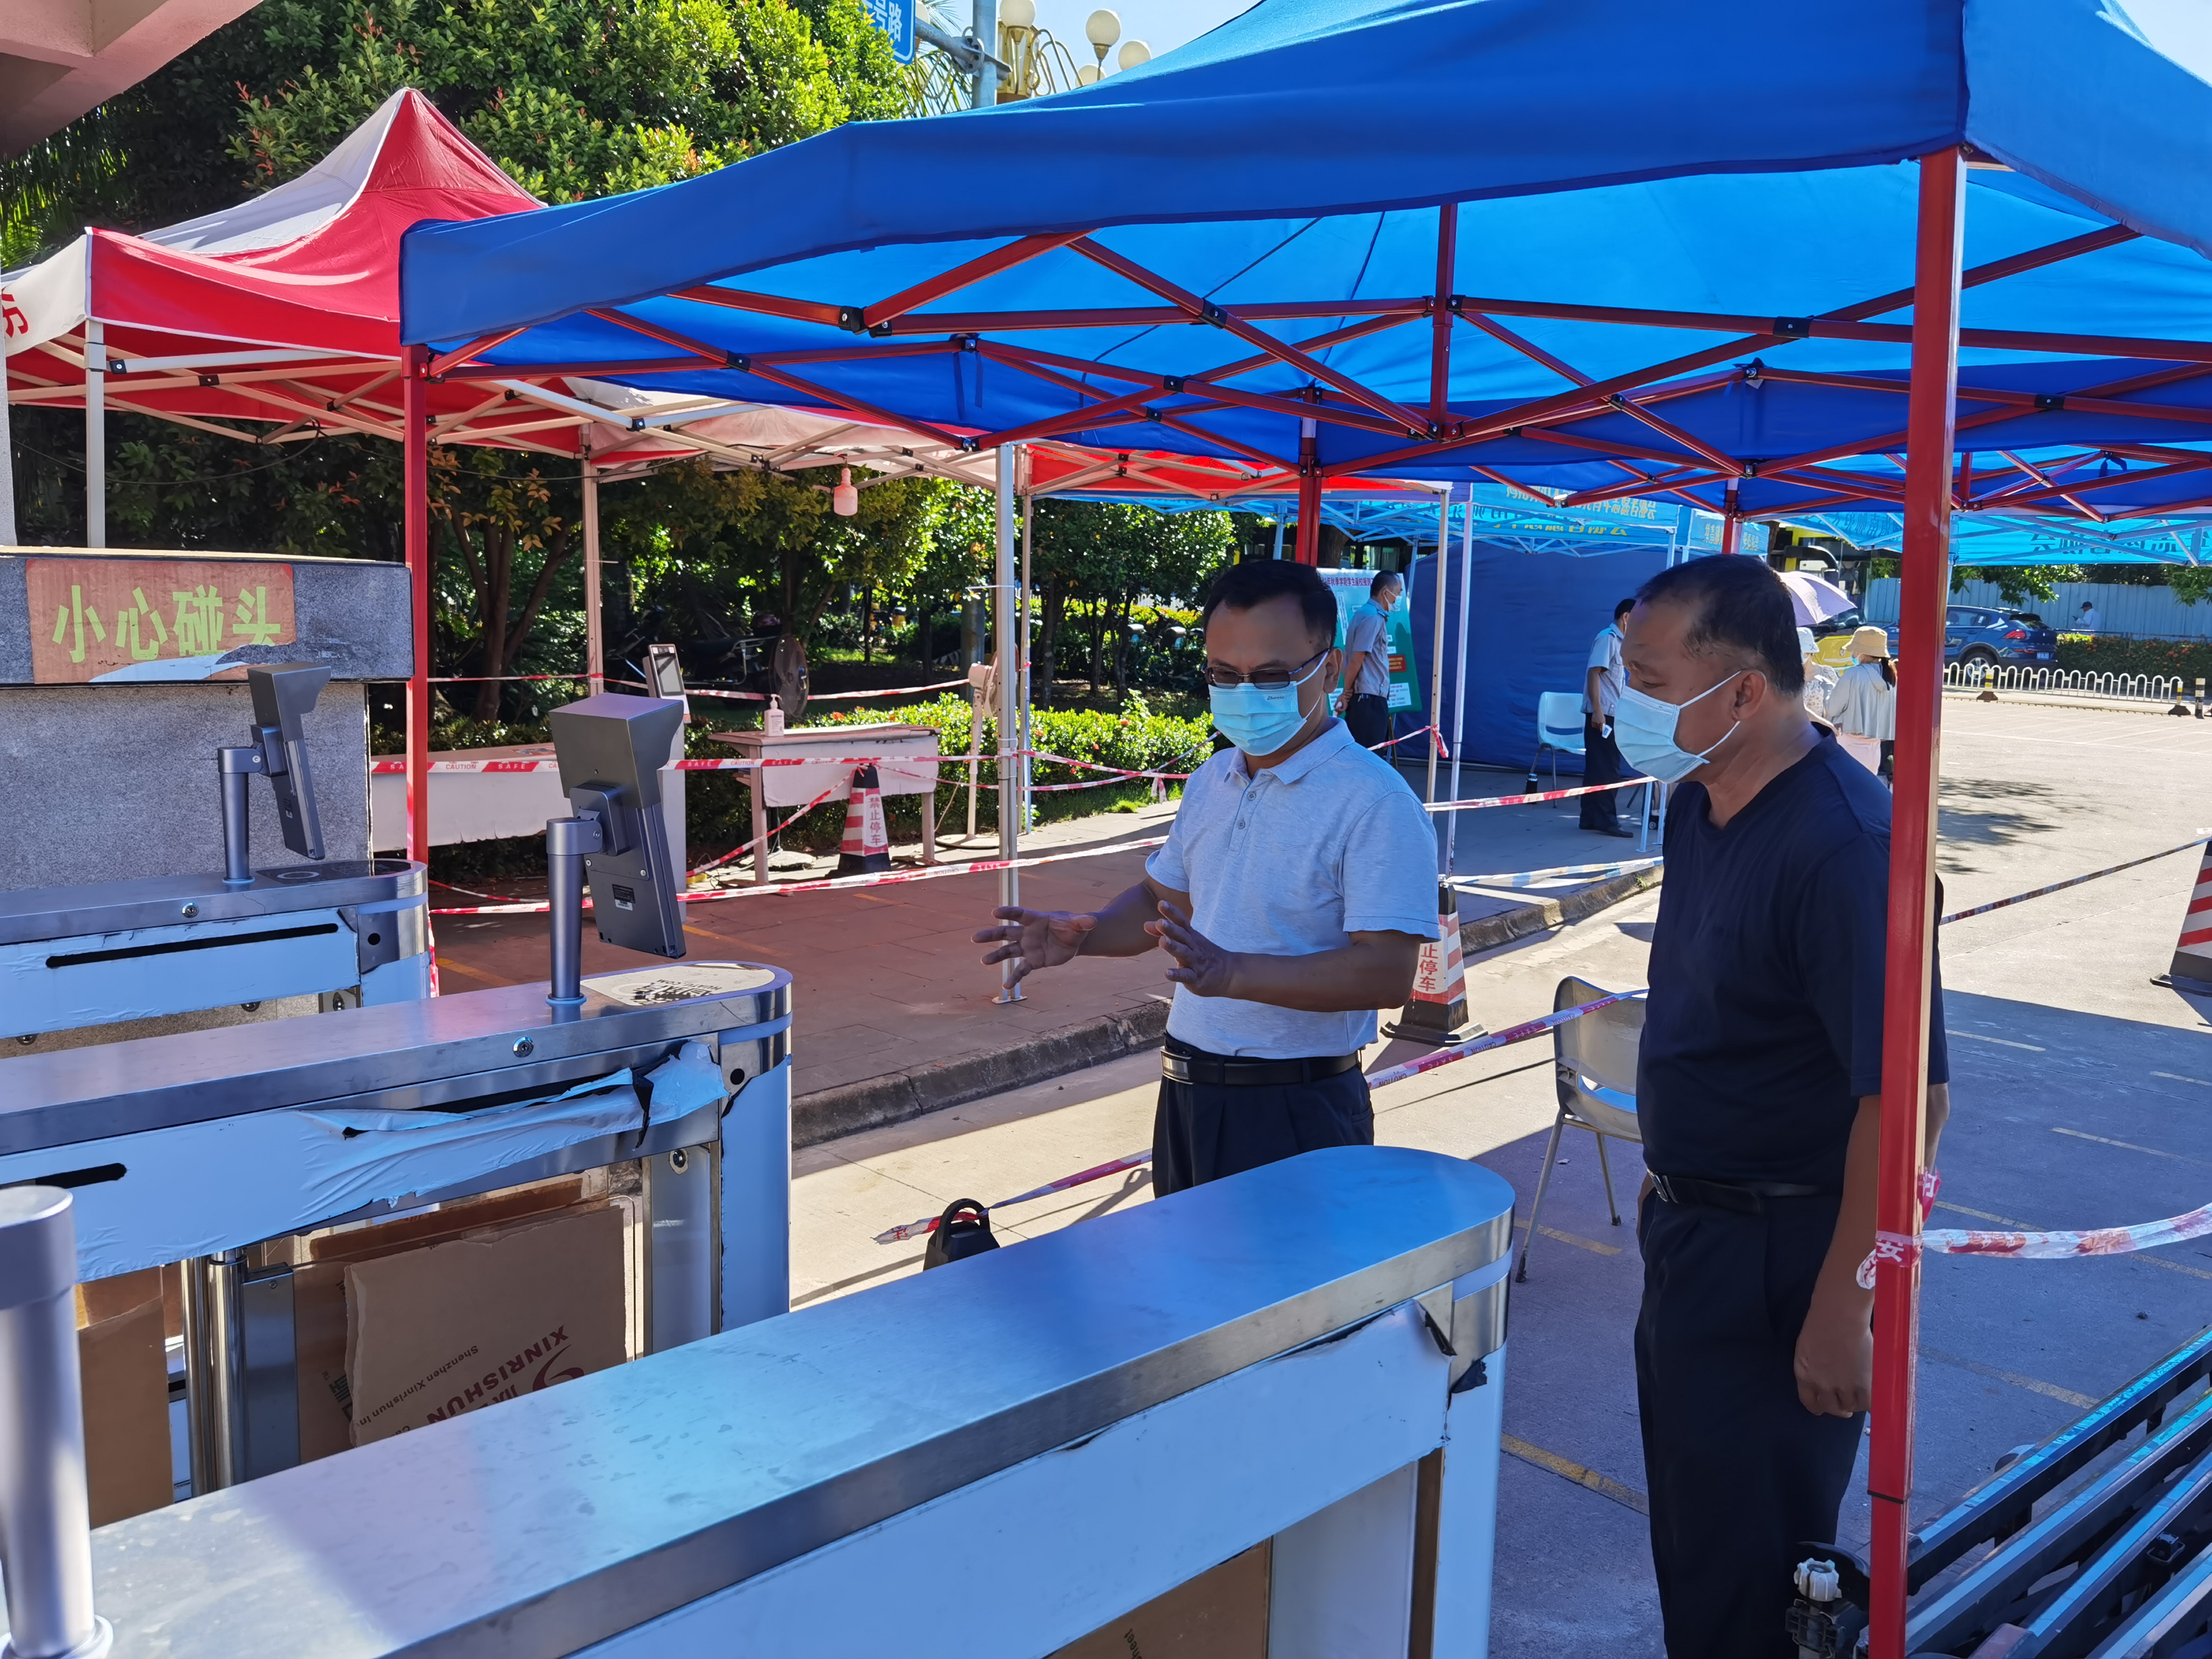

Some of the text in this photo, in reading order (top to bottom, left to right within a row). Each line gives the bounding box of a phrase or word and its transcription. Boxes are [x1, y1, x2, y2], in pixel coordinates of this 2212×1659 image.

[862, 0, 902, 42] 号路
[52, 585, 281, 663] 小心碰头
[869, 797, 881, 846] 禁止停车
[1418, 944, 1439, 992] 止停车
[1379, 1073, 1407, 1087] CAUTION
[426, 1345, 479, 1382] Shenzhen
[427, 1325, 569, 1424] XINRISHUN
[372, 1379, 426, 1417] Xinrishun
[1124, 1628, 1143, 1659] heet
